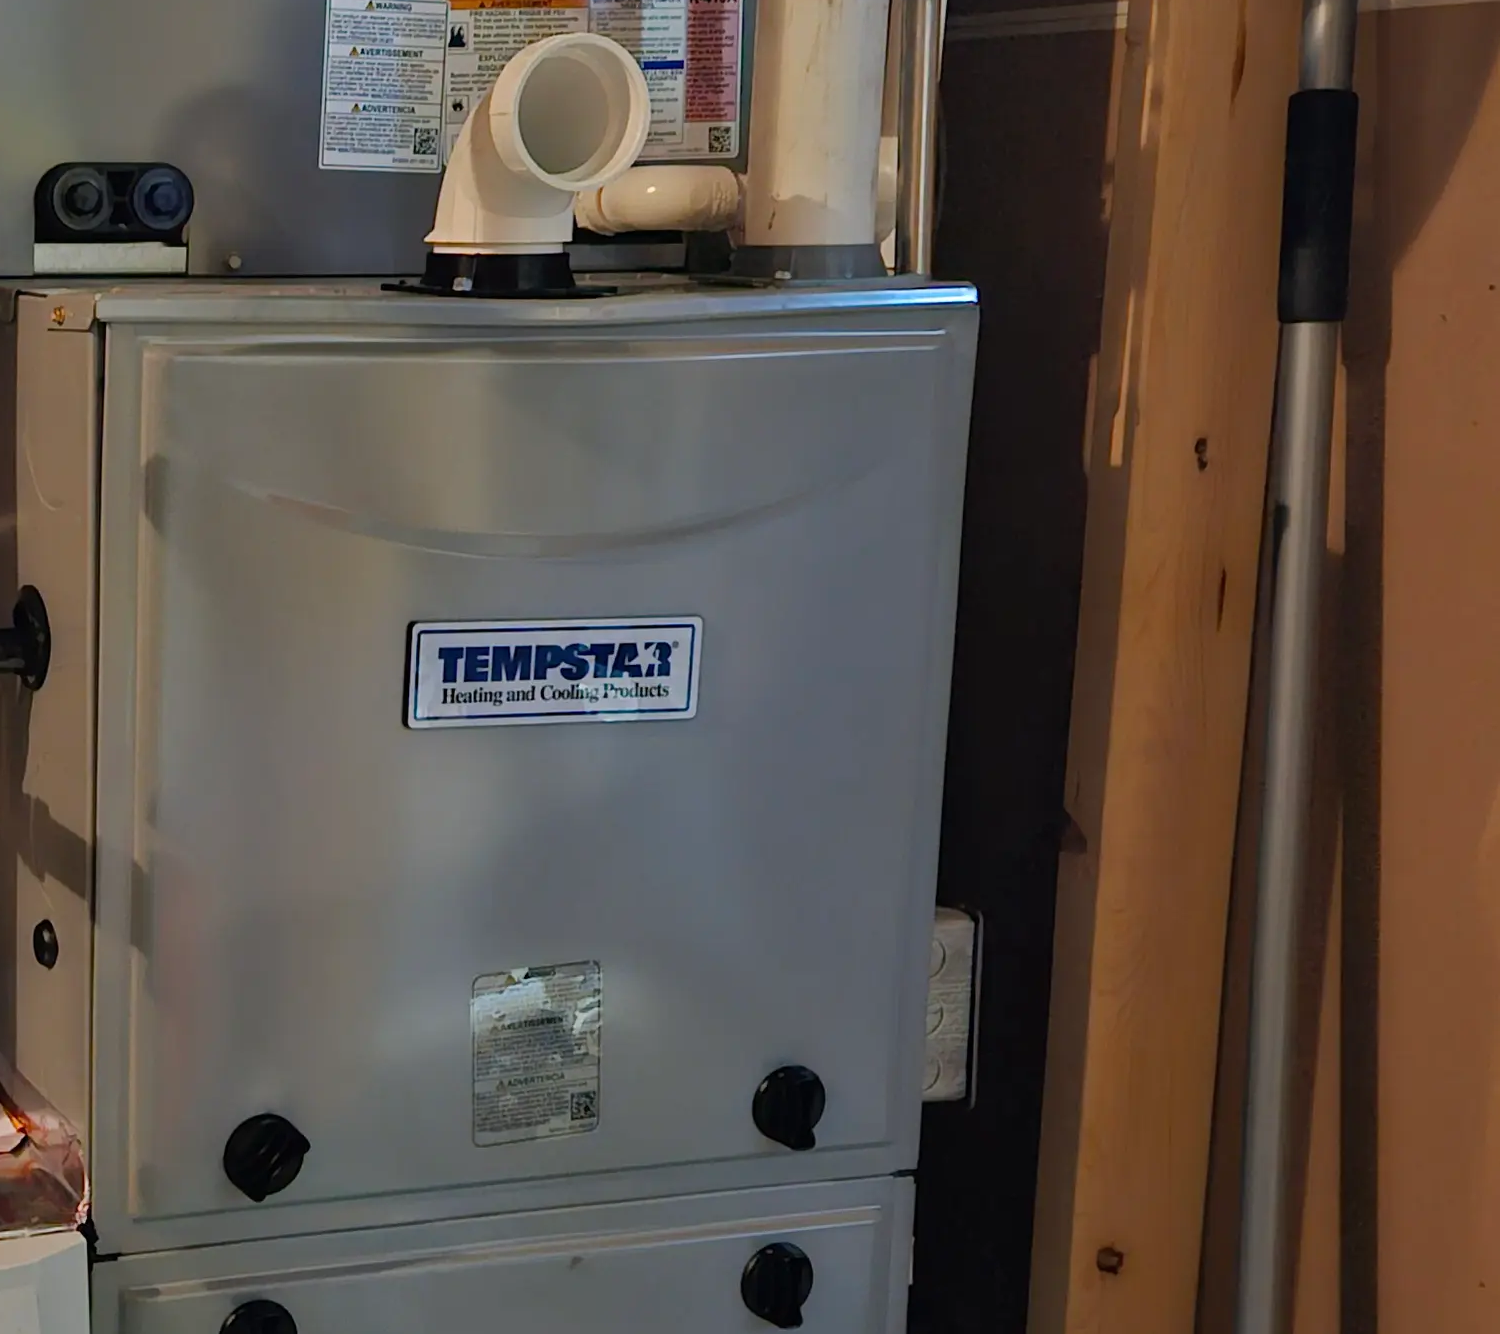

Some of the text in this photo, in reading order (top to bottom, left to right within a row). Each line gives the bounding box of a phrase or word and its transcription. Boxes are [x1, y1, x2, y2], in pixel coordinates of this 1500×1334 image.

[375, 2, 413, 12] WARNING
[359, 47, 424, 58] AVERTISSEMENT
[361, 104, 416, 114] ADVERTENCIA
[438, 641, 673, 684] TEMPSTAR
[441, 681, 670, 707] Heating and Cooling Products
